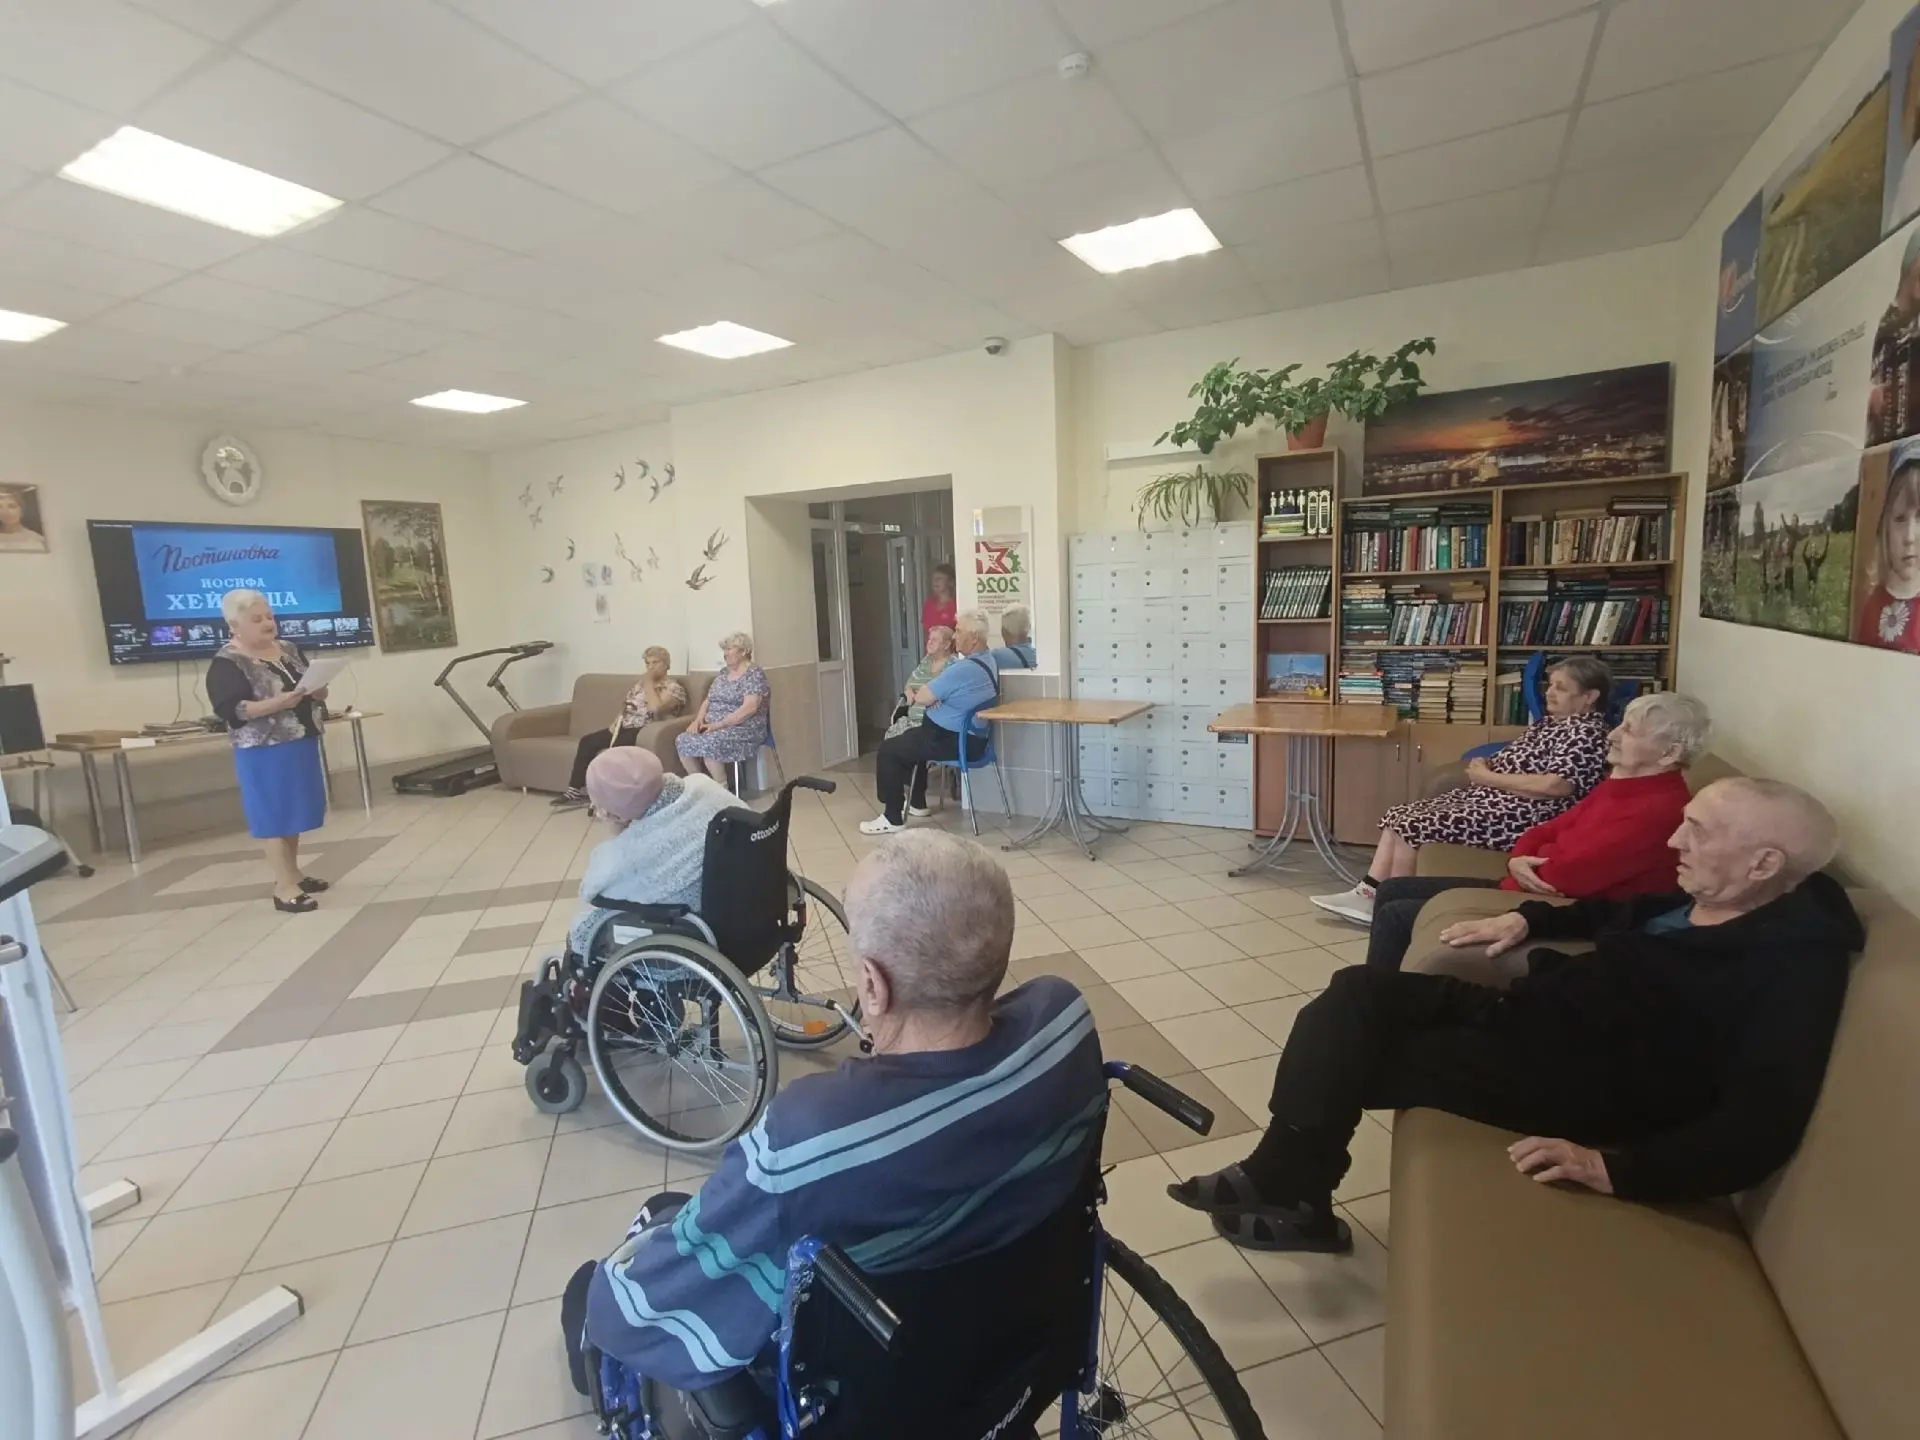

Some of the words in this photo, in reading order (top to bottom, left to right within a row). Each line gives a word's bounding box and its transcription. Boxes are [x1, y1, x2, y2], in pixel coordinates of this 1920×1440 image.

[153, 544, 280, 574] Постановка
[200, 577, 268, 588] ИОСИФА
[166, 591, 299, 611] ХЕЙЦА
